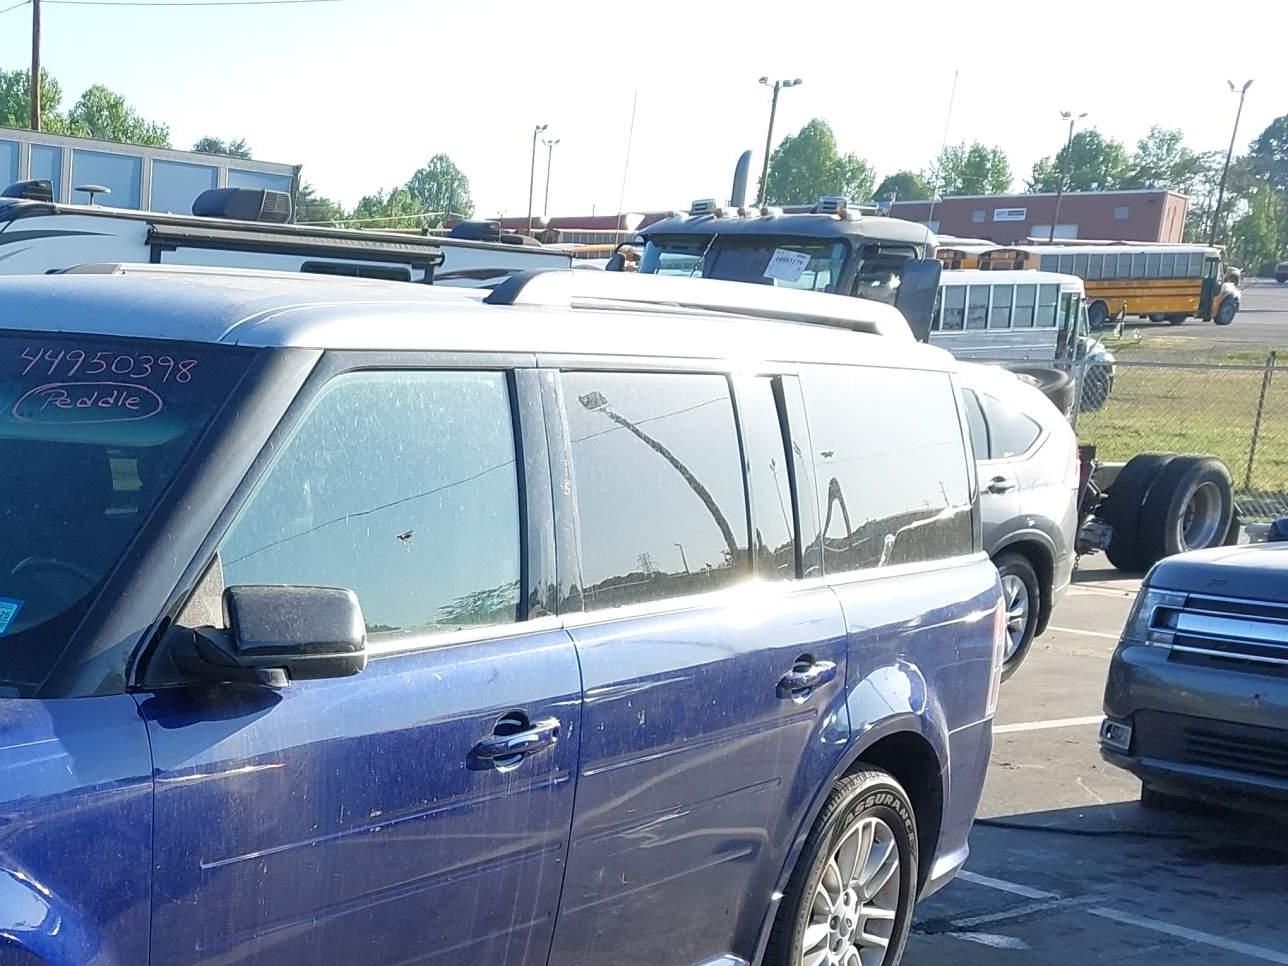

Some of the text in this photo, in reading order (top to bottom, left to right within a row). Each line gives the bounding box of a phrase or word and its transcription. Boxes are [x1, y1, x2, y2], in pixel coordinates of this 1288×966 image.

[20, 346, 199, 384] 44950398
[36, 389, 141, 412] Peddle
[843, 793, 916, 847] ASSURANCE
